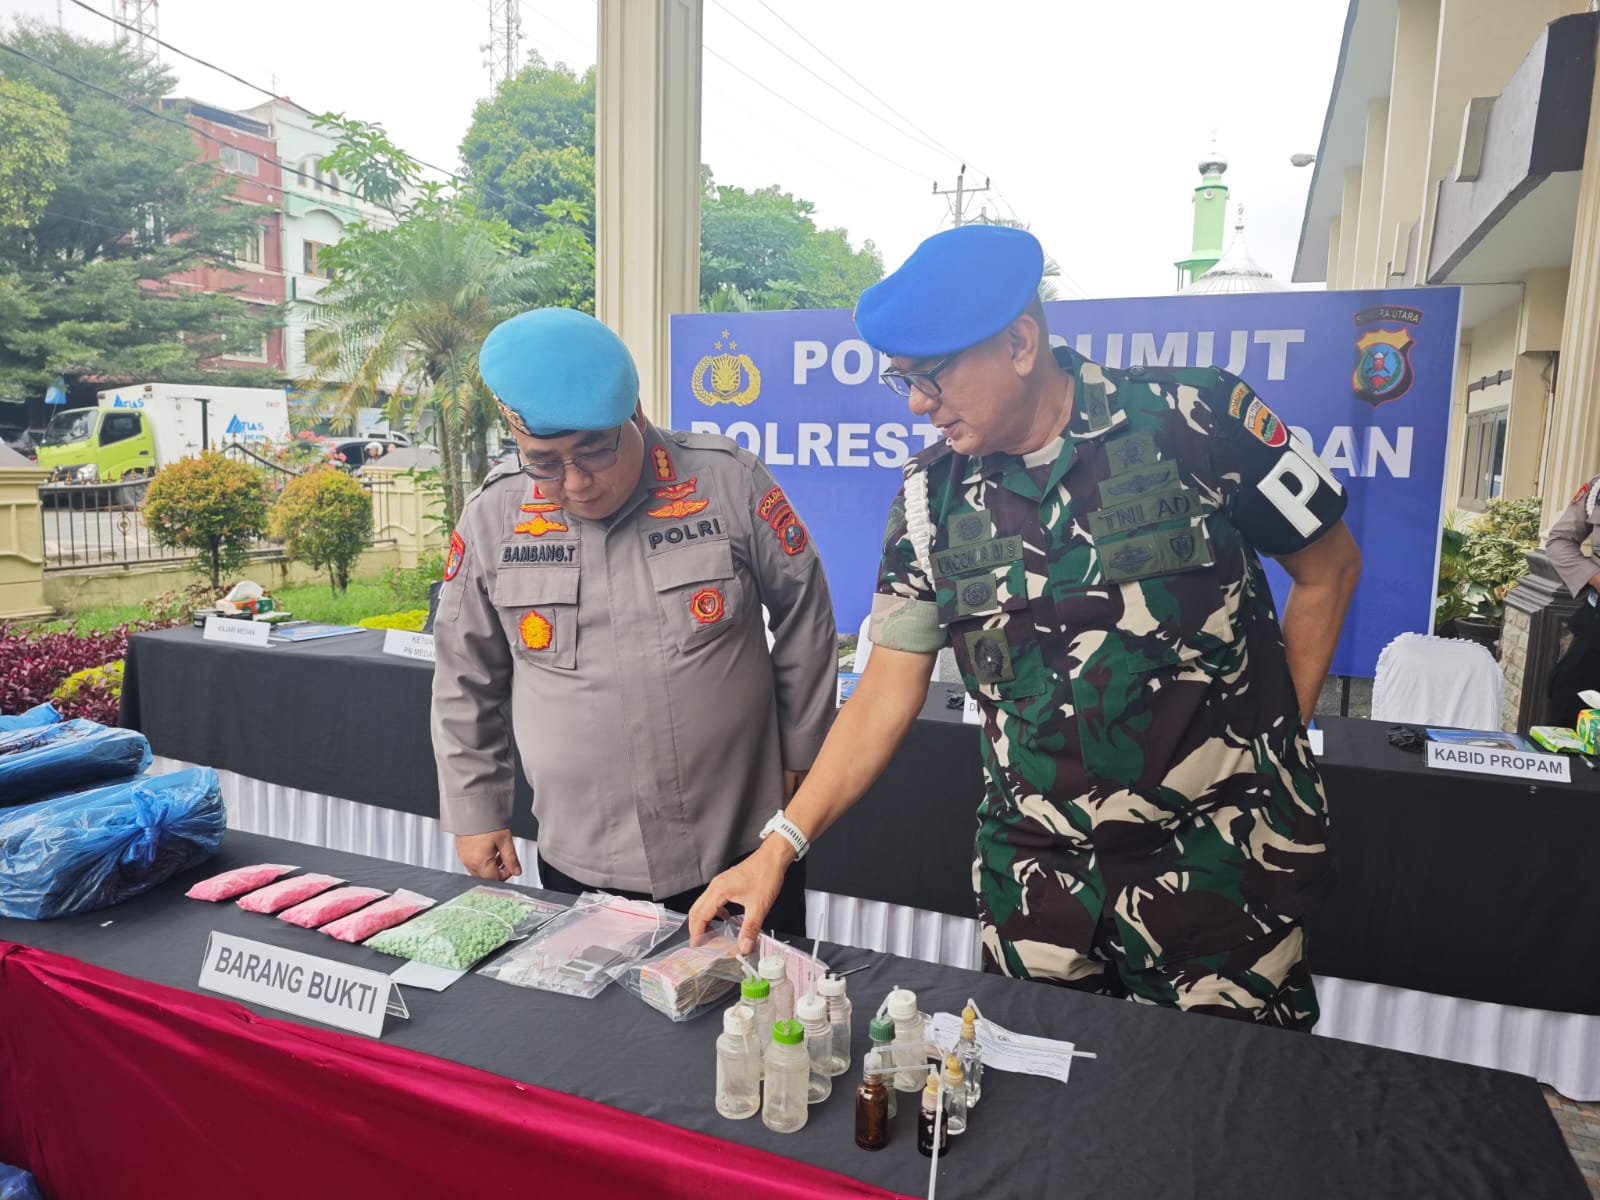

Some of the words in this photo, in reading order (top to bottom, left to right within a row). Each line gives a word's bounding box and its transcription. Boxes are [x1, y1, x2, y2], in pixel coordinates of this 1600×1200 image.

[1392, 309, 1419, 323] UTARA
[1048, 328, 1305, 381] UMUT
[1098, 504, 1145, 528] TNI
[1156, 497, 1191, 517] AD
[649, 518, 721, 549] POLRI
[503, 546, 576, 562] BAMBANG.T
[415, 648, 436, 658] MEDA
[1434, 748, 1485, 766] KABID
[1490, 754, 1563, 774] PROPAM
[214, 946, 304, 994] BARANG
[307, 971, 378, 1014] BUKTI
